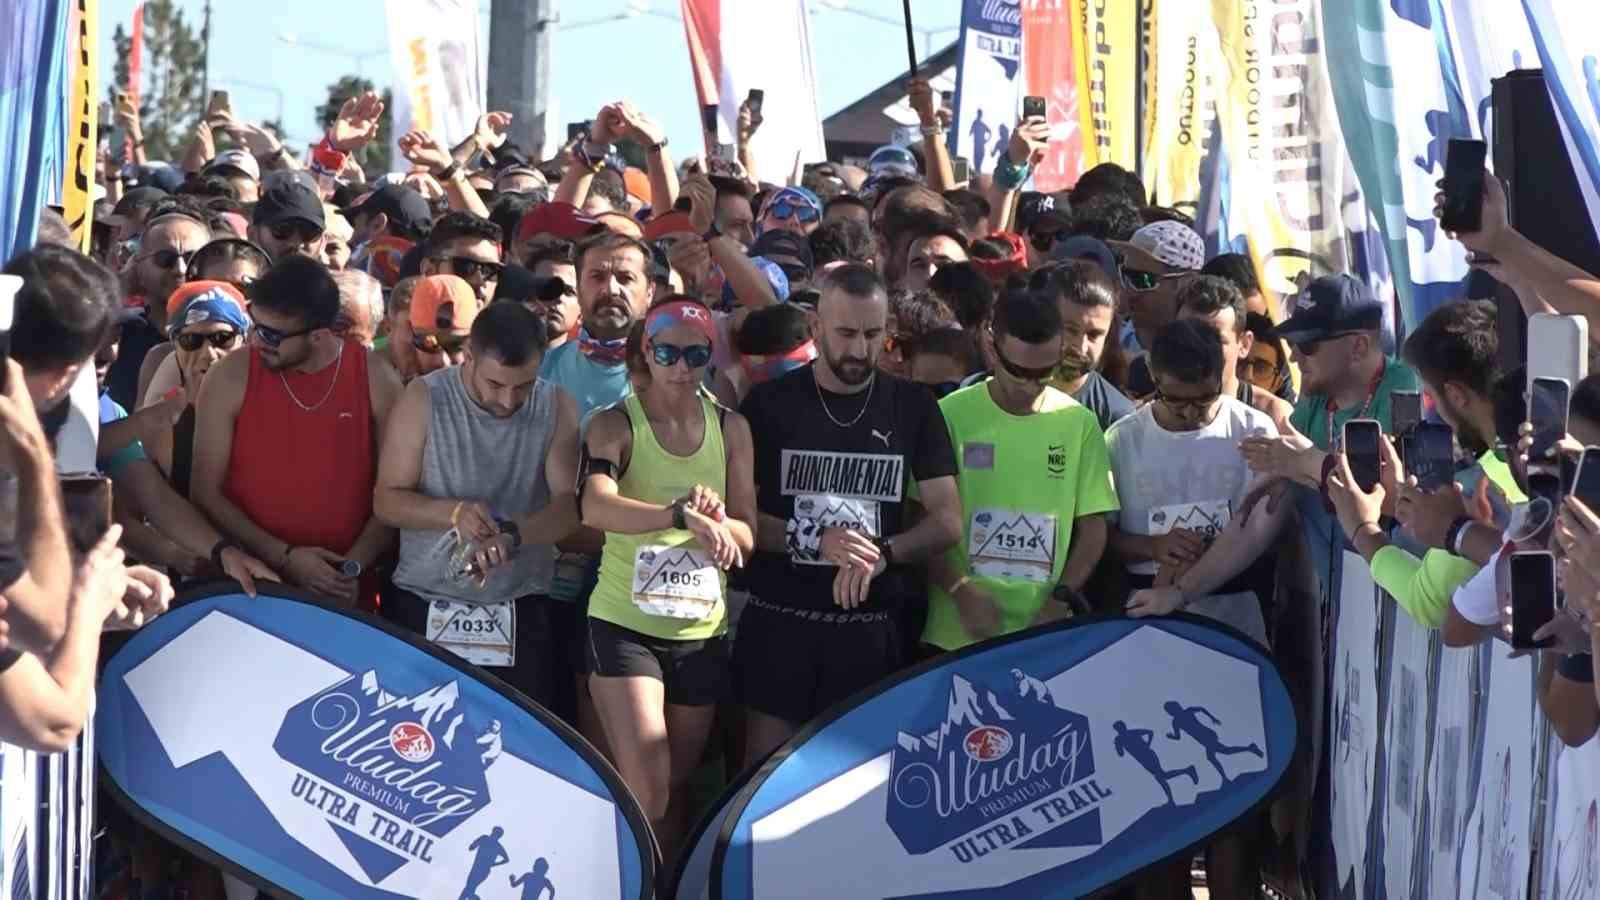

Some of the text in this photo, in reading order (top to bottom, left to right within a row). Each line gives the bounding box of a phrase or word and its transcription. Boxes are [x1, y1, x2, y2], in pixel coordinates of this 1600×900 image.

[785, 454, 901, 497] RUNDAMENTAL
[1047, 454, 1066, 466] NRC
[995, 533, 1038, 549] 1514
[660, 570, 702, 586] 1605
[452, 619, 495, 633] 1033
[343, 772, 411, 815] PREMIUM
[979, 777, 1052, 818] PREMIUM
[290, 773, 434, 864] ULTRA TRAIL
[949, 779, 1113, 864] ULTRA TRAIL
